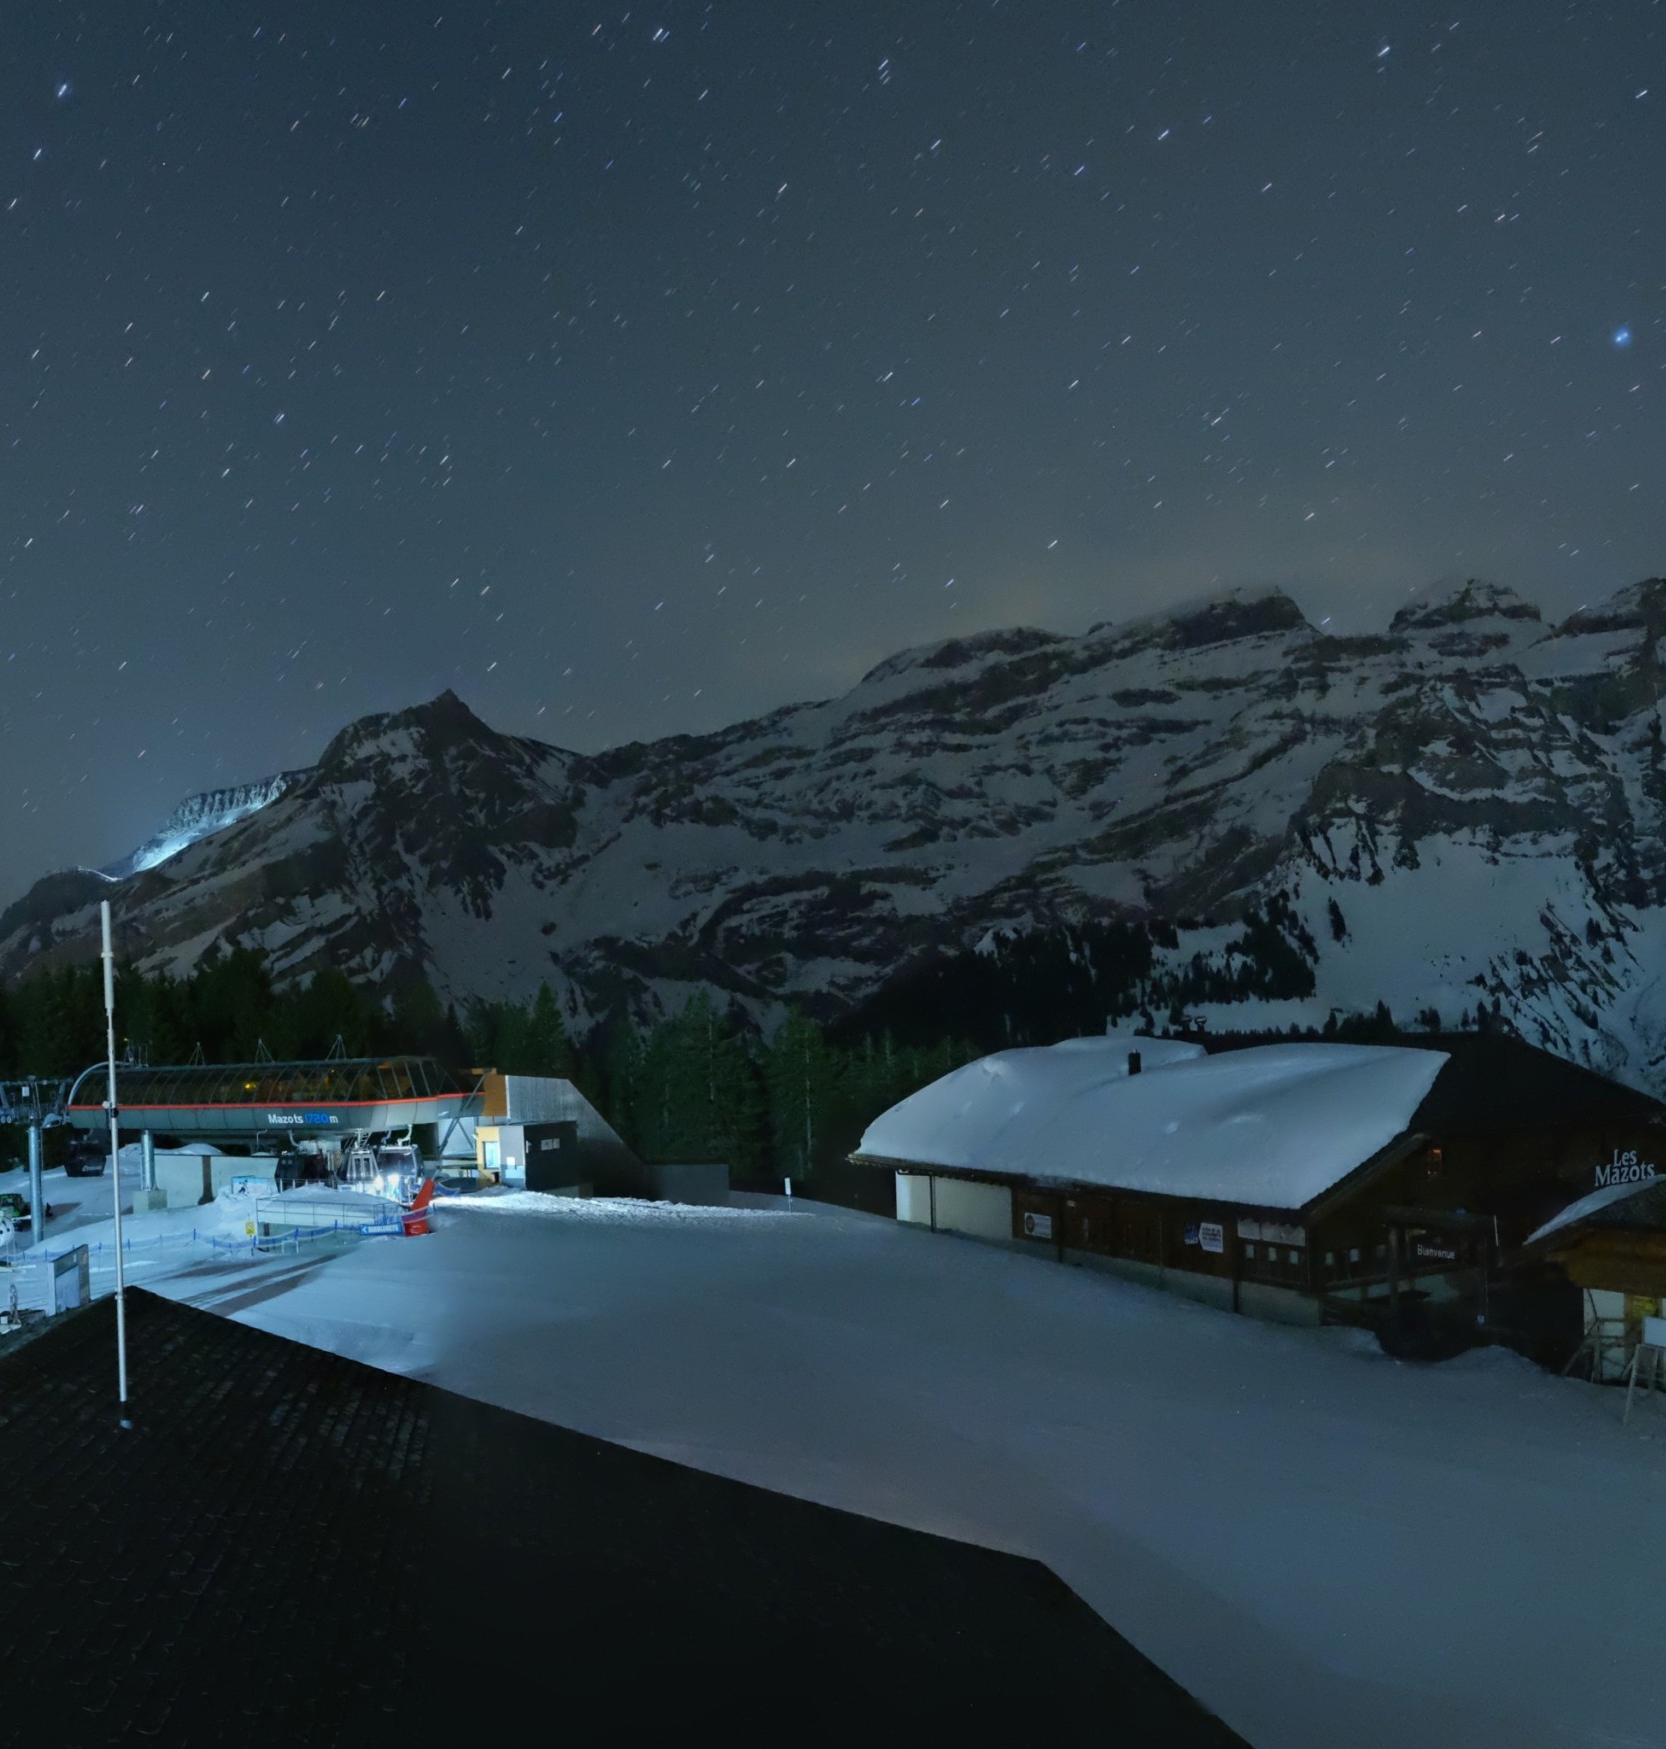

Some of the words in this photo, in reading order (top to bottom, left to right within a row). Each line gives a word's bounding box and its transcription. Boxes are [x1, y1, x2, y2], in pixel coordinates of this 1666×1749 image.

[268, 1113, 304, 1124] Mazots
[329, 1115, 339, 1124] m
[1613, 1148, 1637, 1167] Les
[1594, 1161, 1655, 1187] Mazots
